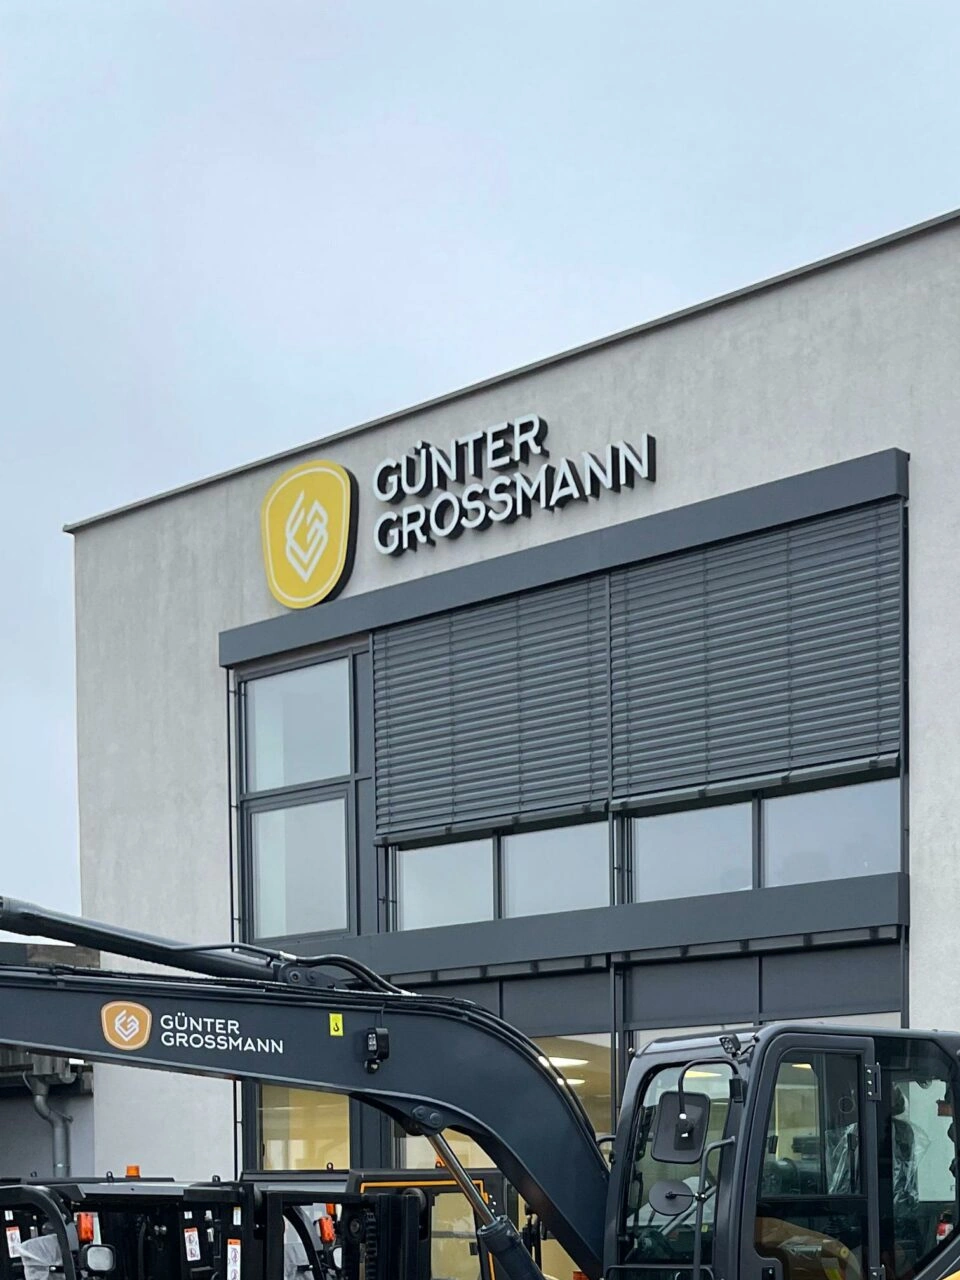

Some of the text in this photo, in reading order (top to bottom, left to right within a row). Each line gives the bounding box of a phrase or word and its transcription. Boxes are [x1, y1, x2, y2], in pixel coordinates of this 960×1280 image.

[373, 413, 544, 501] GÜNTER
[373, 433, 652, 556] GROSSMANN
[160, 1012, 239, 1034] GÜNTER
[160, 1032, 283, 1054] GROSSMANN
